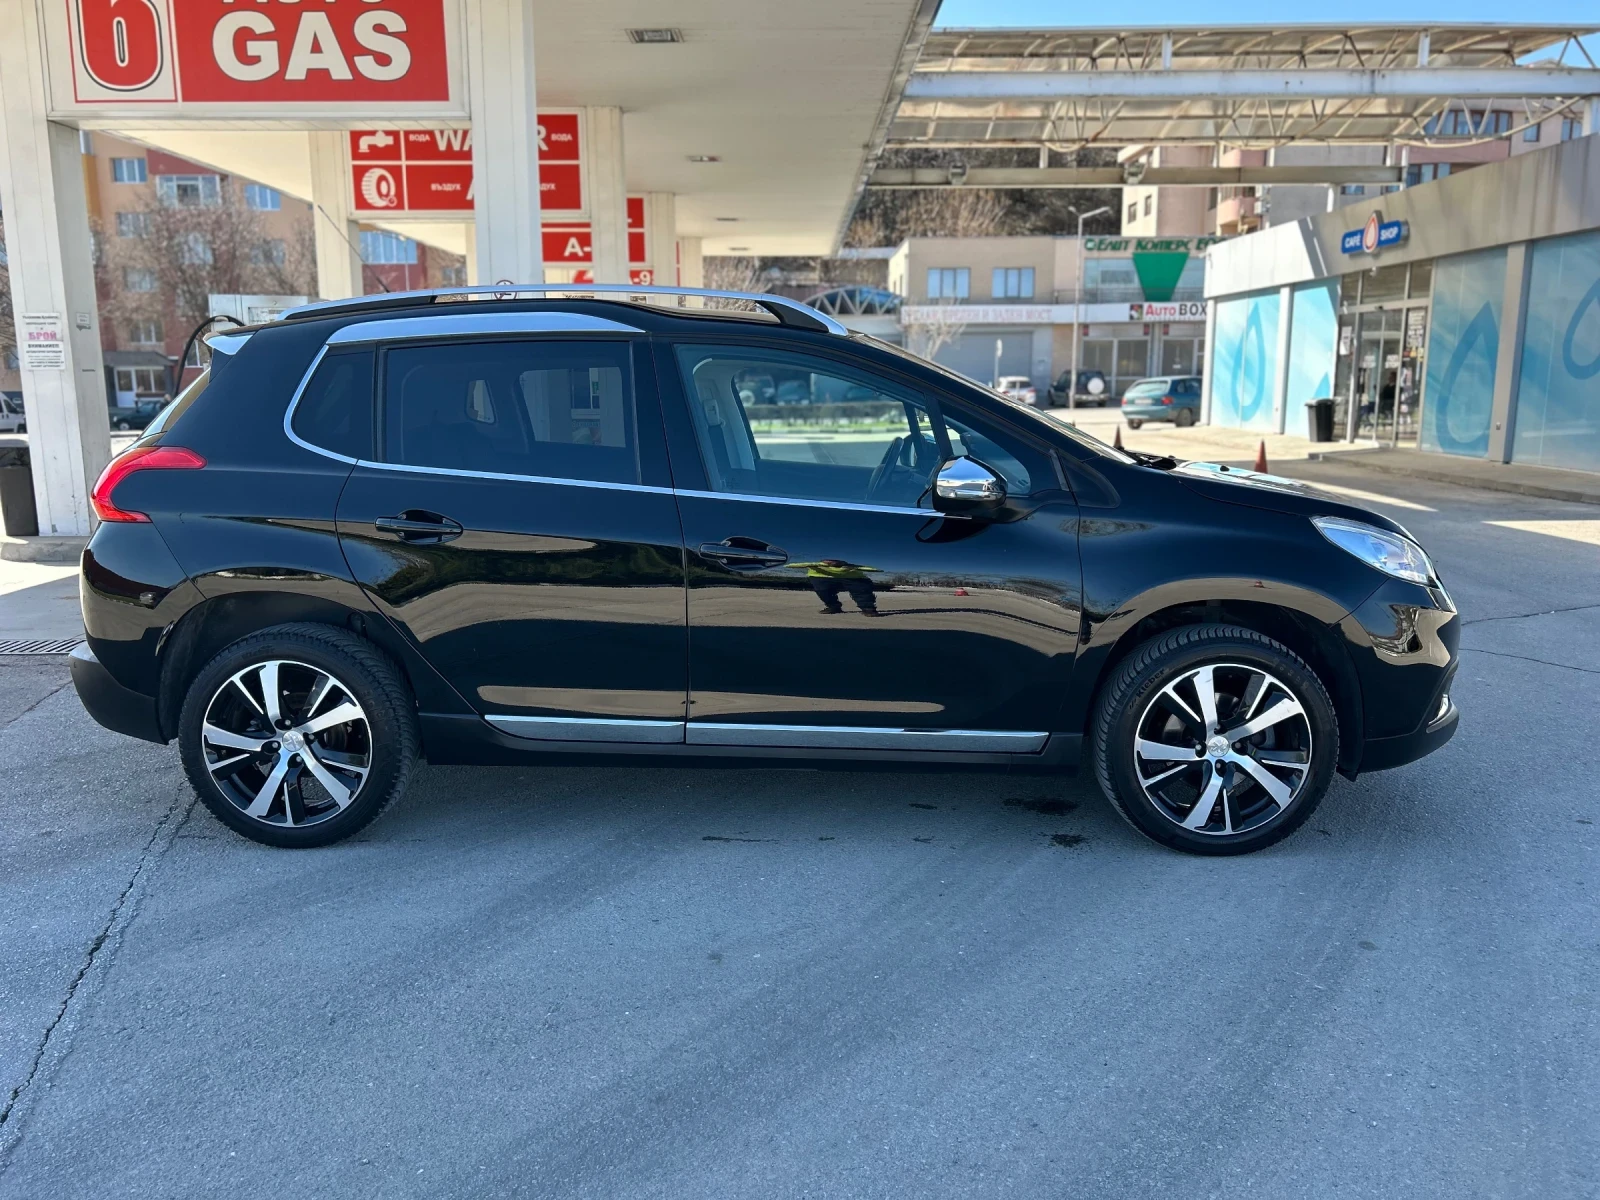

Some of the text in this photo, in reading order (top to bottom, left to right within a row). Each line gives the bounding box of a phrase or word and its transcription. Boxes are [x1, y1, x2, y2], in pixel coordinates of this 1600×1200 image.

[212, 10, 412, 81] GAS
[409, 134, 430, 142] ВОДА
[551, 133, 573, 141] ВОДА
[430, 183, 461, 191] ВЪЗДУХ
[1380, 226, 1399, 241] SHOP
[1179, 303, 1207, 316] BOX
[28, 330, 57, 340] БРОЙ
